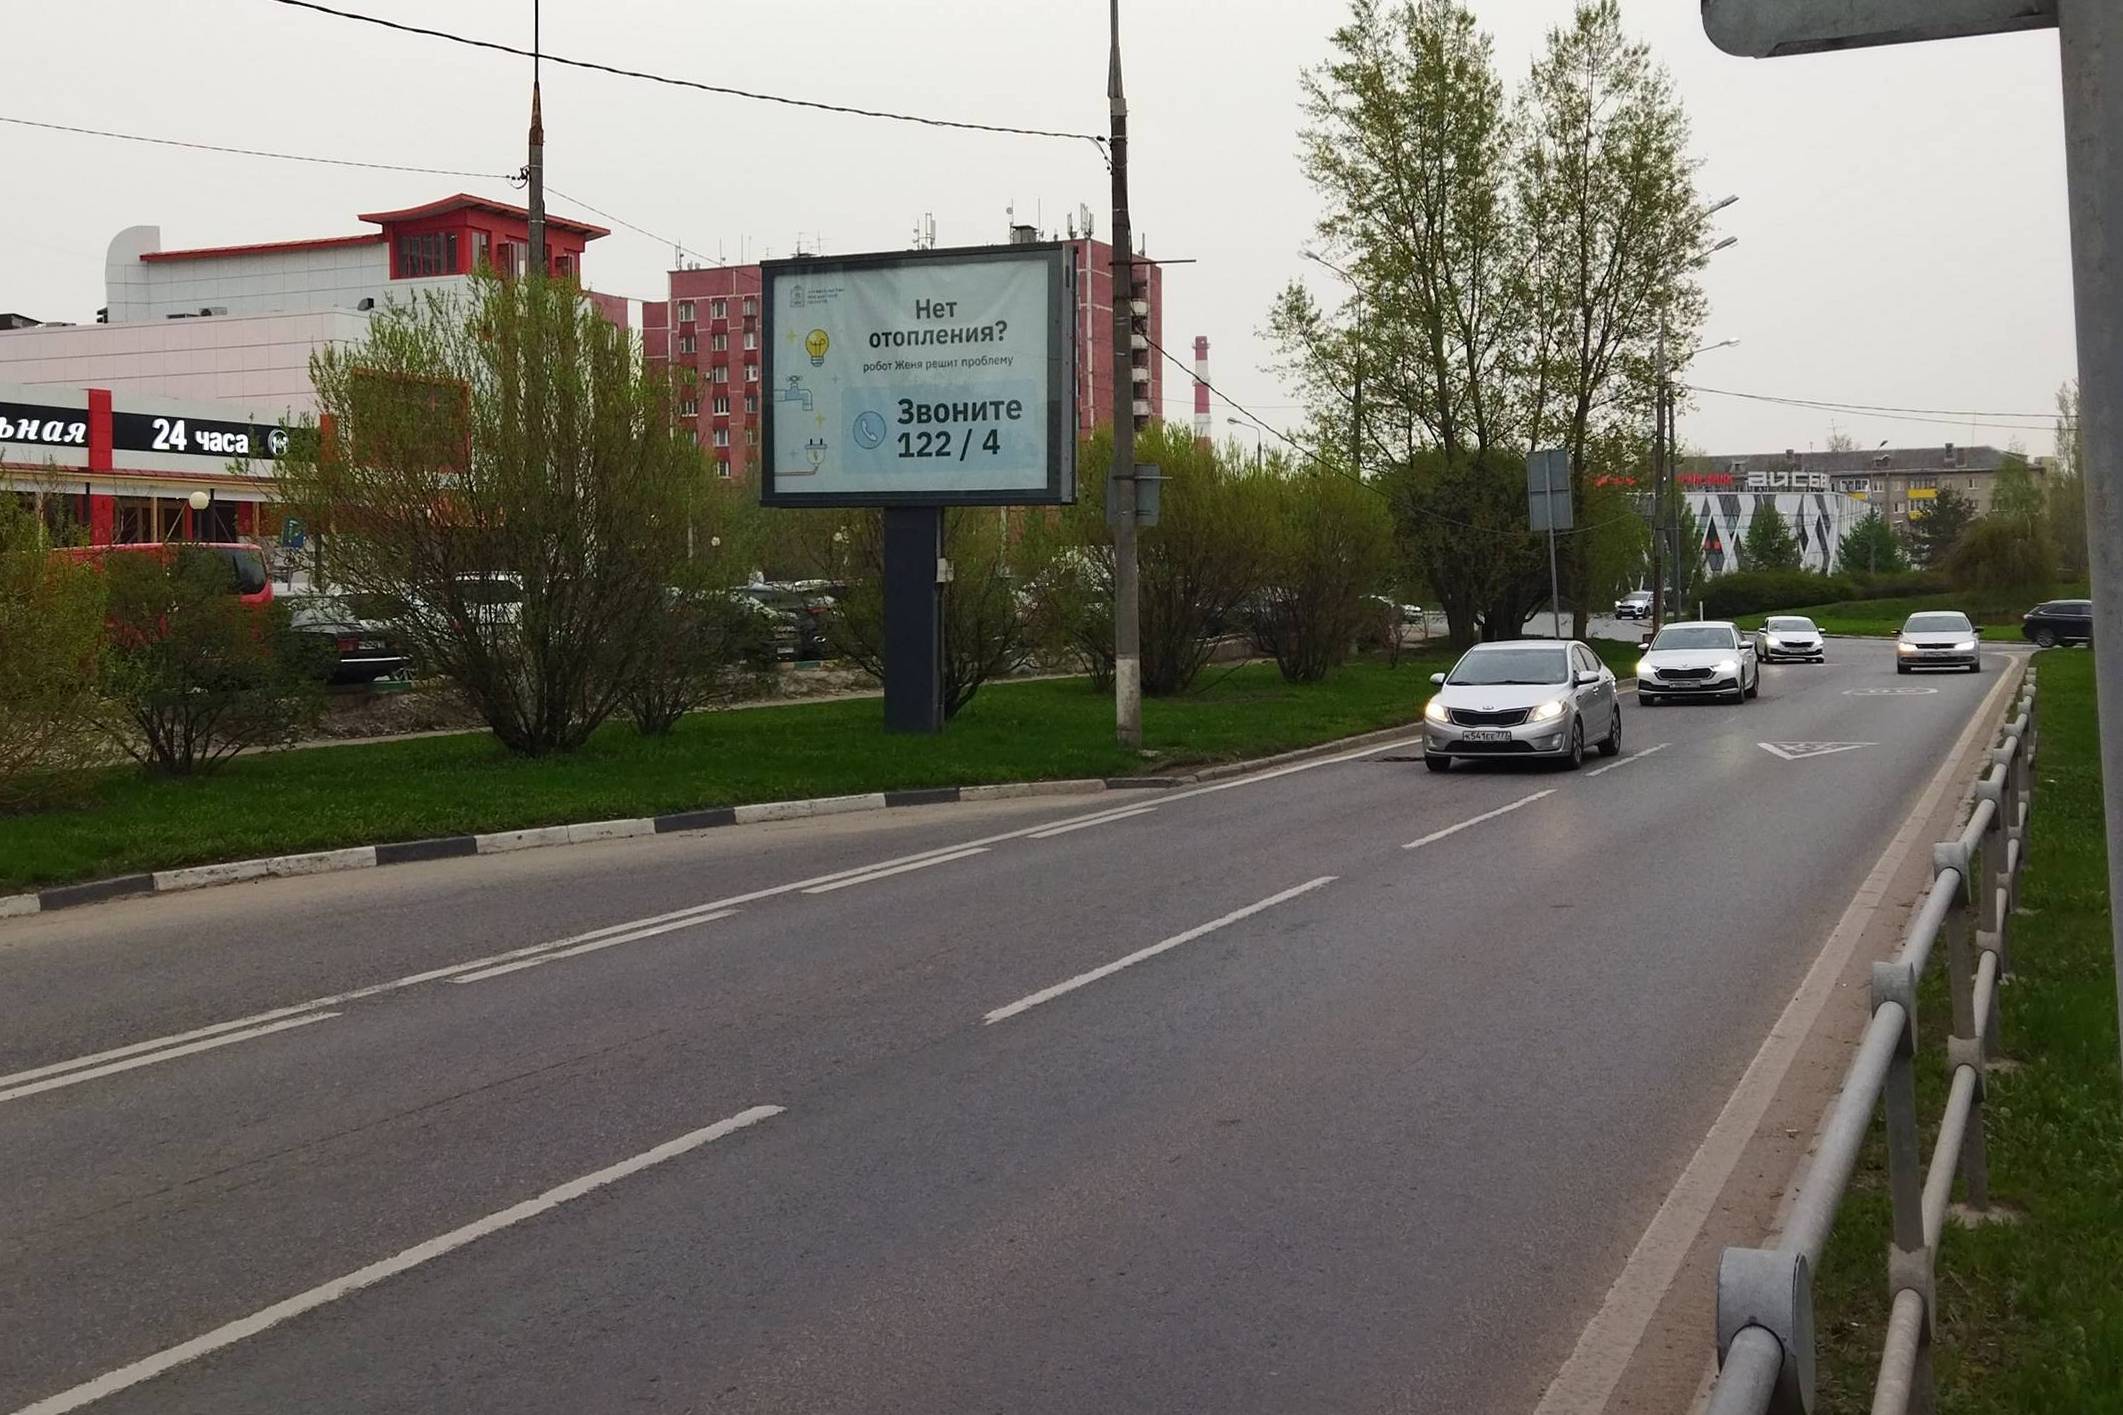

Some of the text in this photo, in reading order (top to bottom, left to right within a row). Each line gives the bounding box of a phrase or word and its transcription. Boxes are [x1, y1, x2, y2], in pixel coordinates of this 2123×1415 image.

[915, 298, 958, 320] Нет
[869, 320, 1008, 348] отопления?
[863, 354, 1014, 373] робот Женя решит проблему
[897, 398, 1023, 425] Звоните
[0, 416, 87, 444] ьная
[151, 417, 187, 451] 24
[194, 430, 249, 454] часа
[897, 430, 951, 458] 122
[982, 428, 1001, 455] 4
